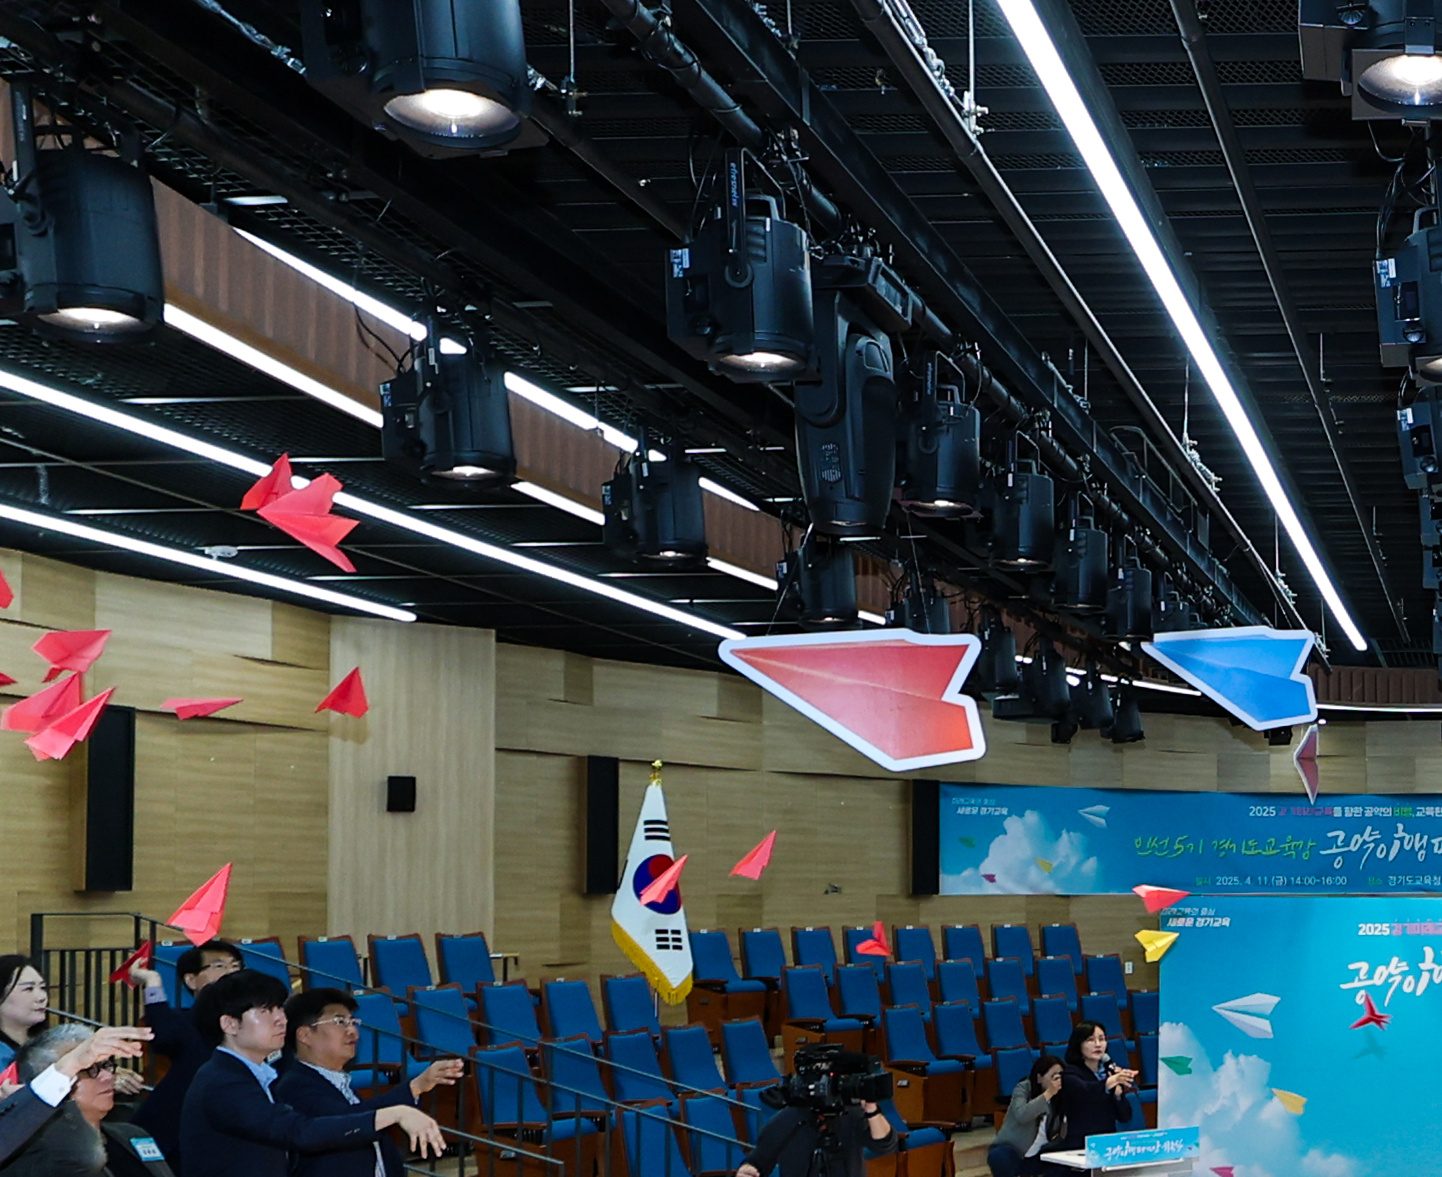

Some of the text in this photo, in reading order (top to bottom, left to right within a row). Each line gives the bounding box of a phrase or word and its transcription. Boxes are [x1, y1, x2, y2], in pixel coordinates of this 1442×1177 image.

[1249, 806, 1276, 817] 2025
[1344, 806, 1362, 817] 향한
[1364, 806, 1392, 817] 공약의
[1387, 875, 1441, 887] 경기도교육청
[1167, 916, 1231, 928] 새로운 경기교육
[1358, 923, 1390, 935] 2025
